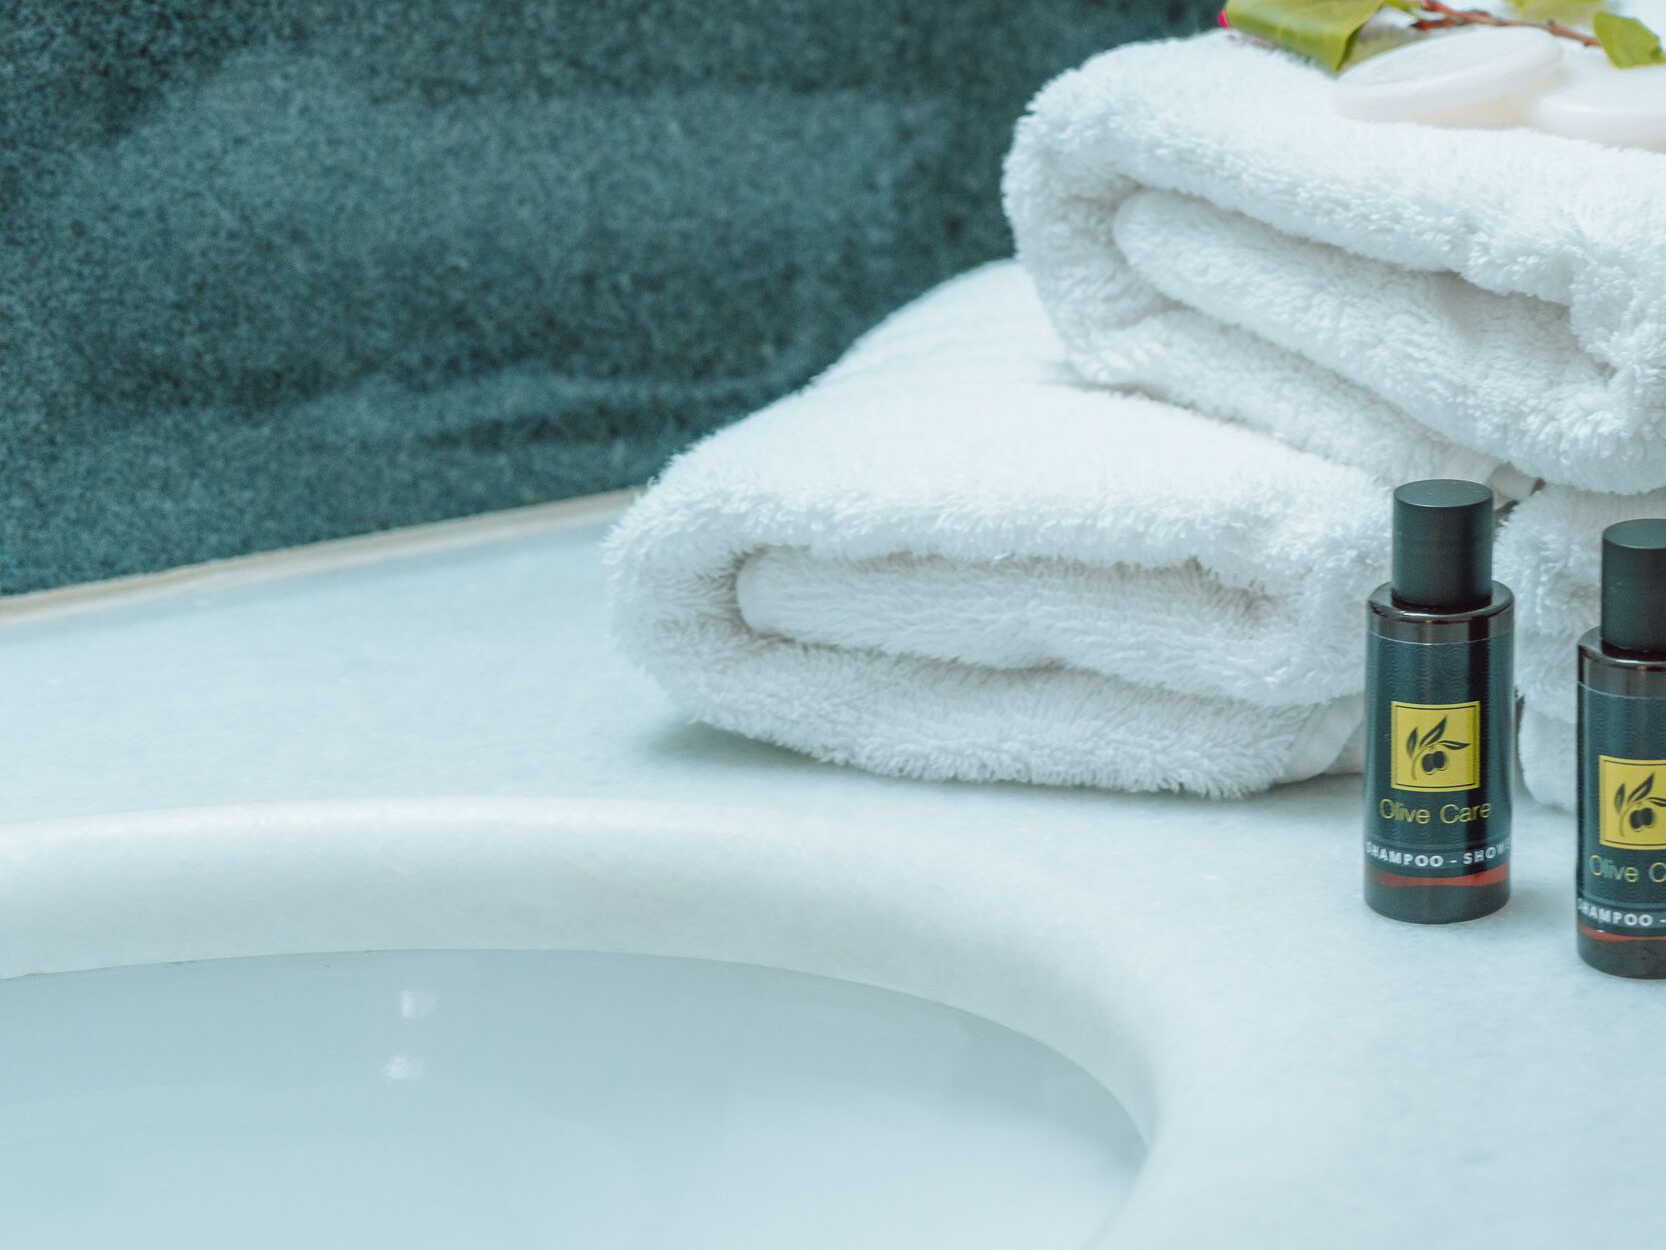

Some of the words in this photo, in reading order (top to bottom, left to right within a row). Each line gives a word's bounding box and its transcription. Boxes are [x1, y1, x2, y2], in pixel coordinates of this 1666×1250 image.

[1379, 798, 1431, 825] Olive
[1439, 803, 1492, 824] Care
[1366, 841, 1444, 867] SHAMPOO
[1588, 854, 1639, 883] Olive
